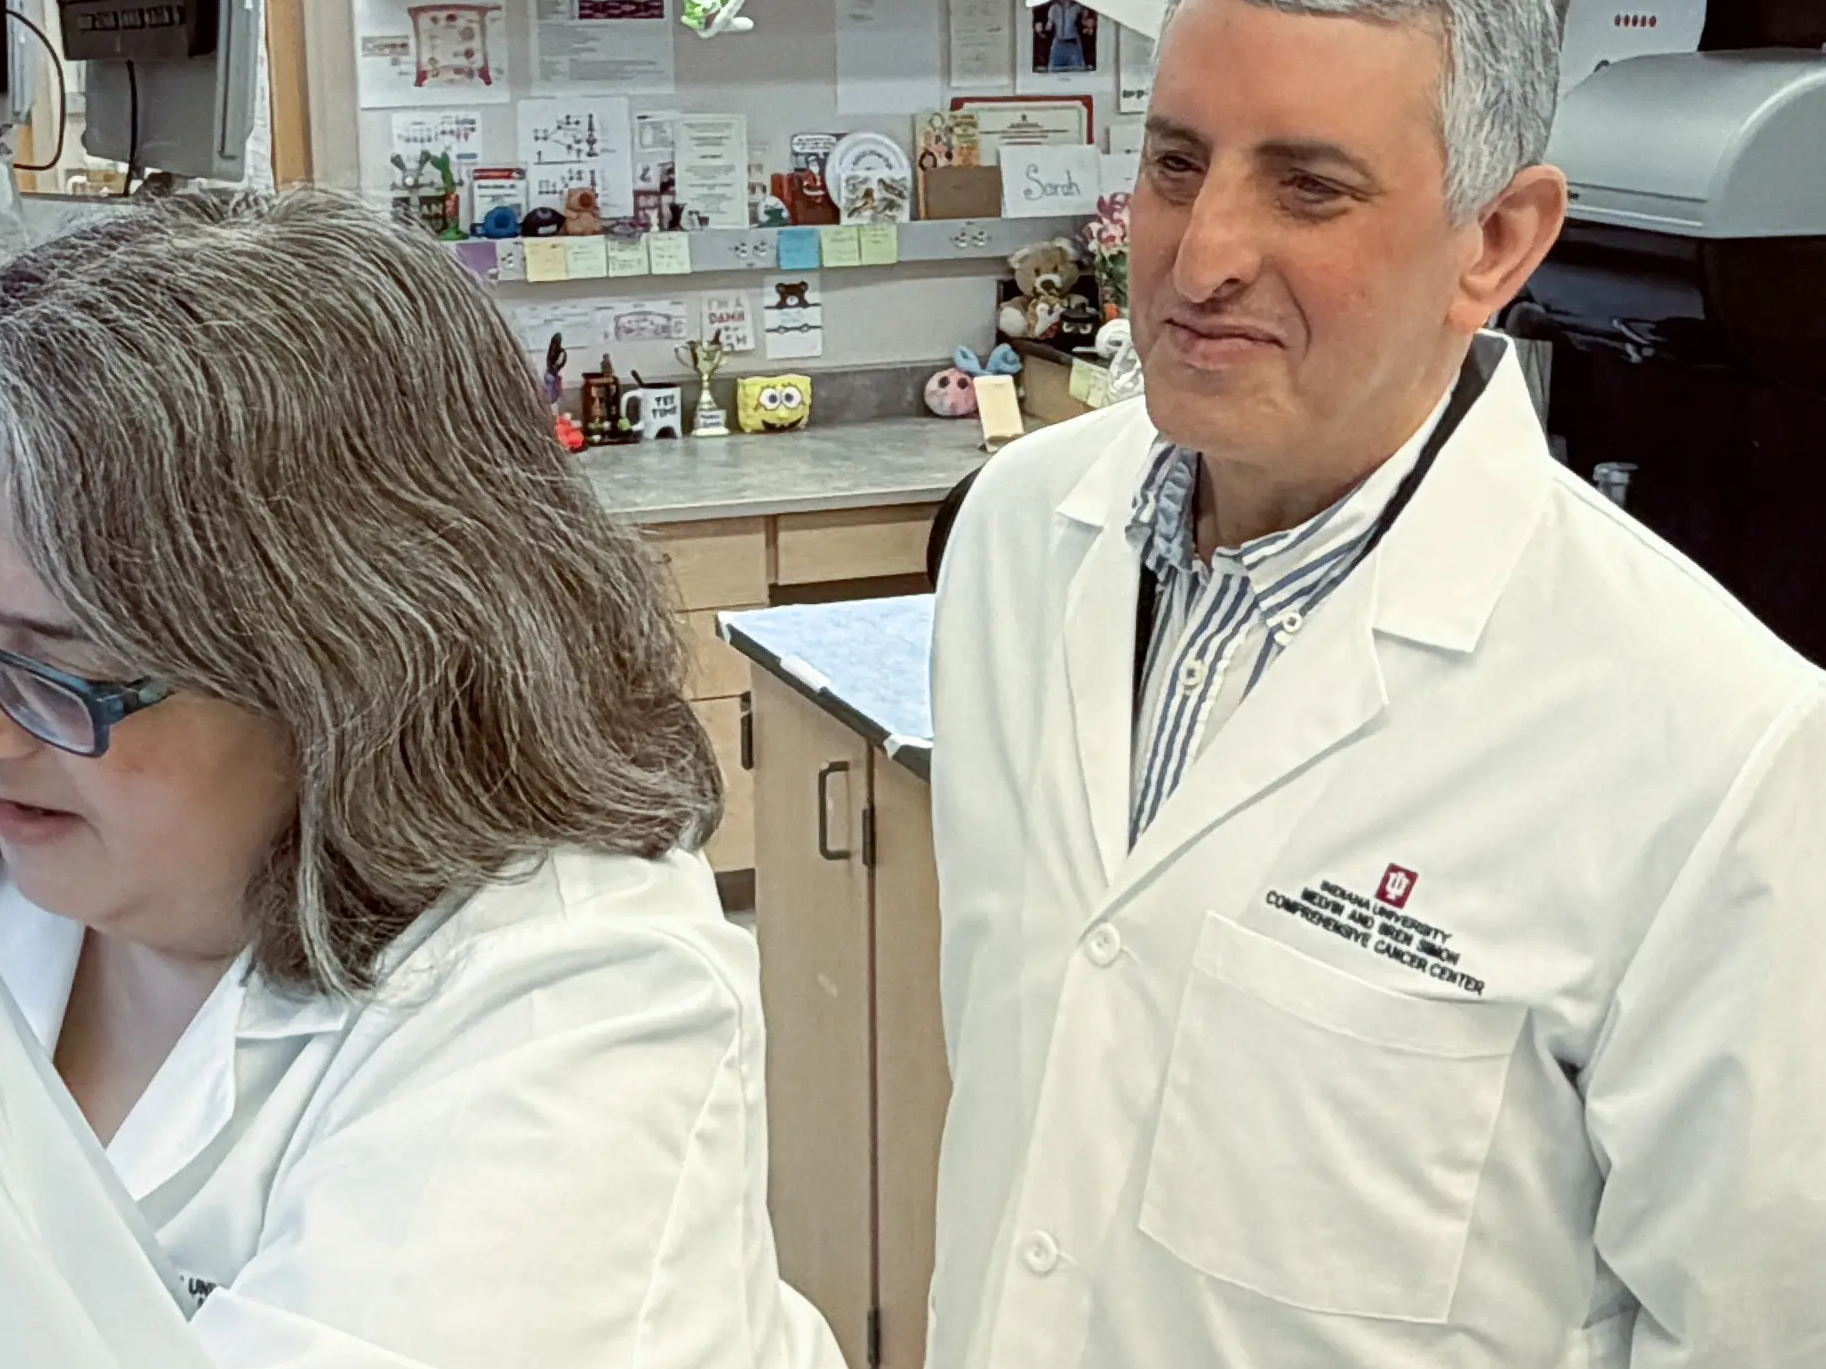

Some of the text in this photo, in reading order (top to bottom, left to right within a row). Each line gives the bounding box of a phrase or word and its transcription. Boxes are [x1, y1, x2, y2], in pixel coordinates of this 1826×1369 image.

[1023, 164, 1081, 200] Sarah
[1321, 879, 1452, 943] INDIANA UNIVERSITY
[1348, 909, 1375, 929] AND
[1417, 938, 1460, 964] SIMON
[1266, 890, 1485, 996] COMPREHENSIVE CANCER CENTER
